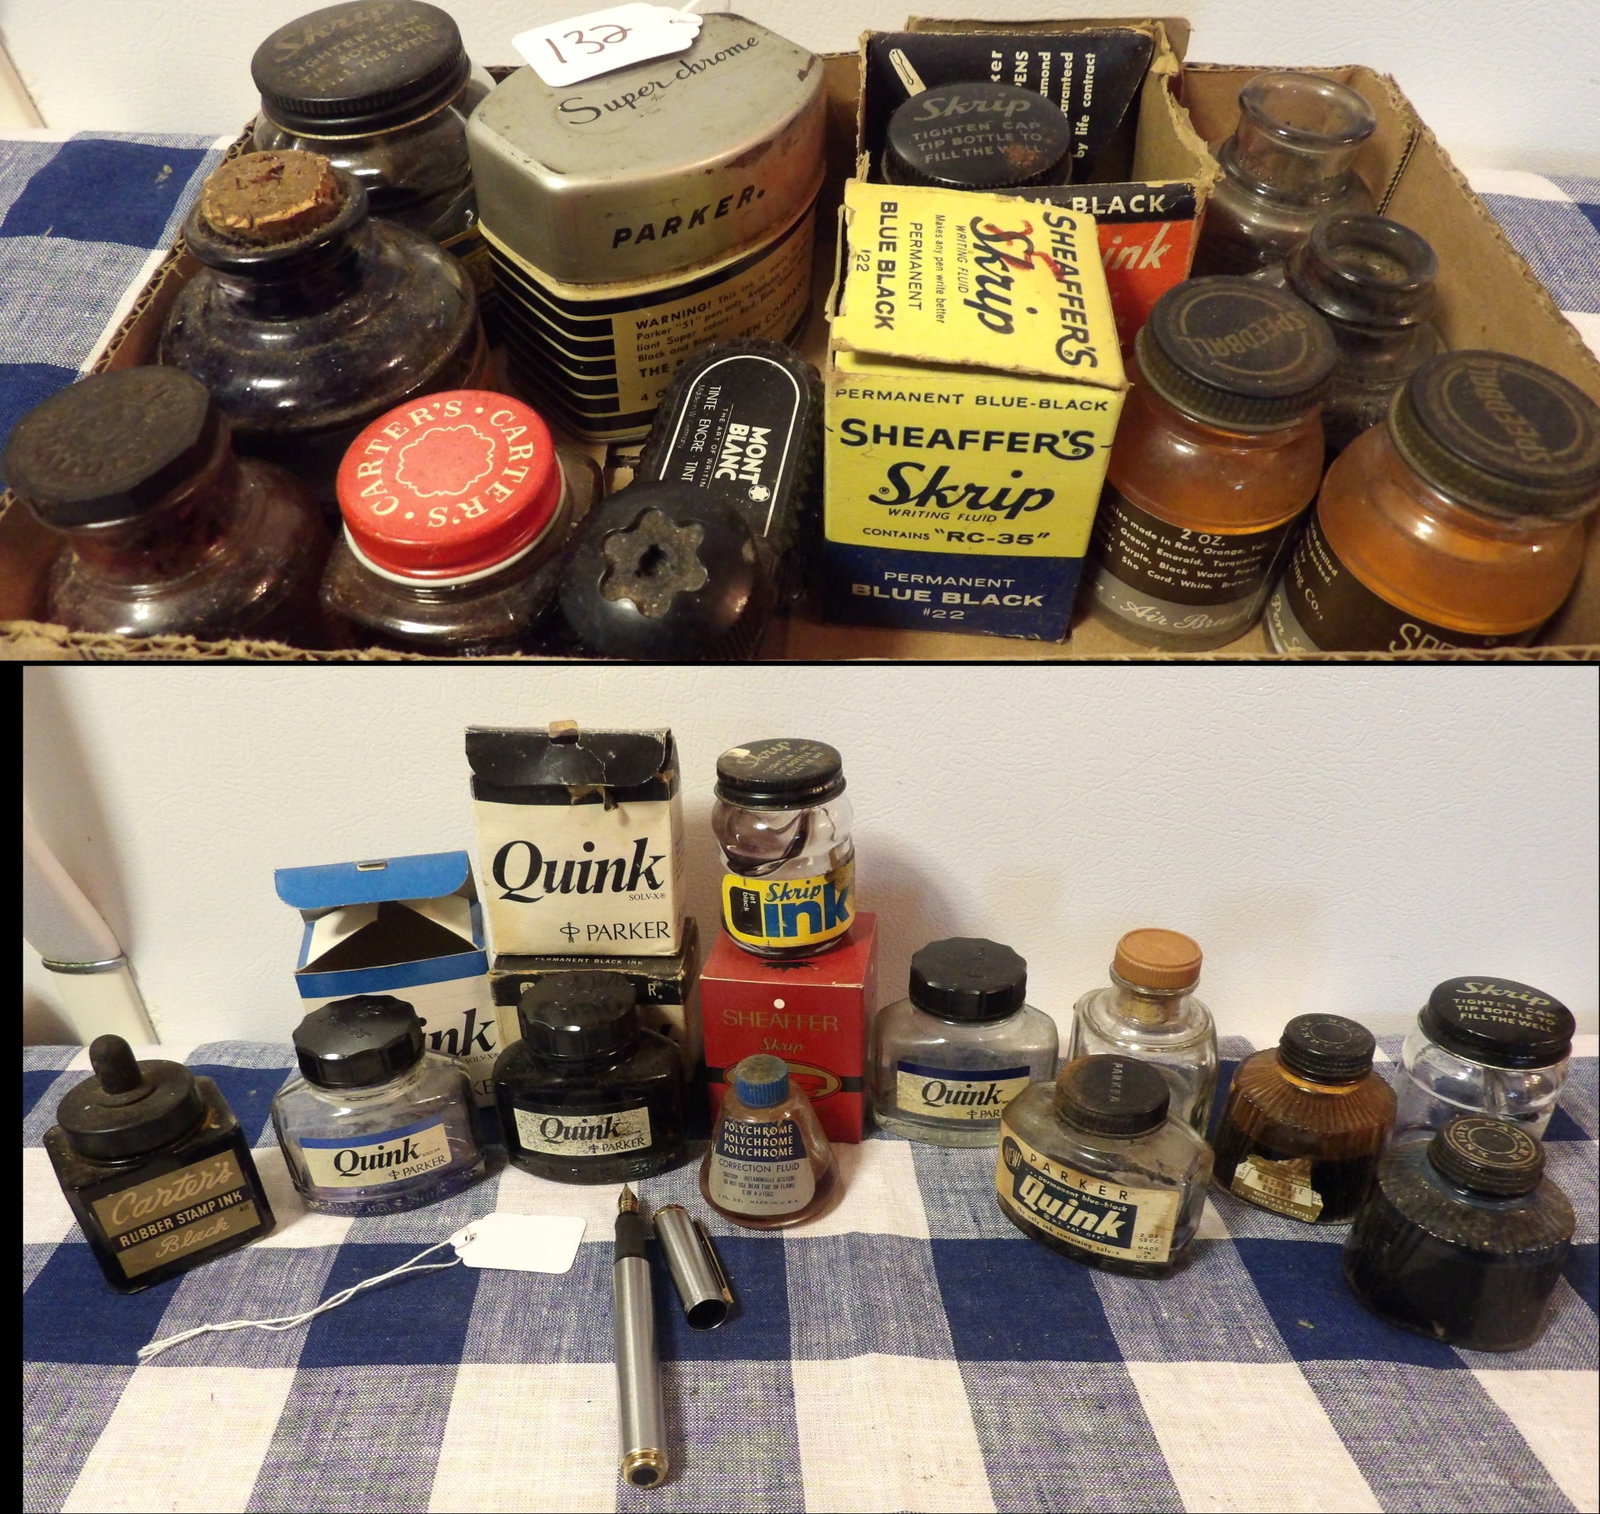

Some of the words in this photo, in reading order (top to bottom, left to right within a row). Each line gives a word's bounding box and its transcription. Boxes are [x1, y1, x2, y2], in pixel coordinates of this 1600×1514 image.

[544, 24, 632, 64] 132
[1081, 53, 1097, 108] contract
[913, 93, 1031, 121] Skrip
[912, 122, 990, 141] TIGHTEN
[1002, 121, 1041, 130] CAP
[1075, 114, 1090, 137] life
[918, 140, 945, 152] TIP
[952, 132, 1015, 146] BOTTLE
[1021, 133, 1042, 142] TO
[1074, 142, 1089, 159] by
[924, 152, 961, 164] FILL
[962, 146, 994, 157] THE
[1072, 195, 1166, 214] BLACK
[878, 201, 898, 253] BLUE
[935, 214, 946, 238] Makes
[935, 240, 944, 255] any
[955, 224, 969, 265] WRITING
[908, 222, 923, 311] PERMANENT
[935, 256, 945, 271] pen
[963, 216, 1039, 335] Skrip
[935, 273, 945, 295] write
[957, 266, 970, 294] FLUID
[1043, 211, 1098, 369] SHEAFFER'S
[874, 260, 897, 331] BLACK
[635, 301, 712, 330] WARNING!
[935, 297, 945, 324] better
[636, 327, 672, 341] Parker
[704, 311, 723, 323] pen
[667, 330, 697, 345] Super
[638, 350, 665, 363] Black
[669, 343, 690, 355] and
[639, 363, 669, 378] THE
[704, 385, 721, 411] TINTE
[836, 389, 964, 405] PERMANENT
[975, 395, 1108, 411] BLUE-BLACK
[718, 408, 729, 422] THE
[690, 418, 711, 452] ENCRE
[714, 426, 724, 442] ART
[840, 417, 1095, 461] SHEAFFER'S
[357, 399, 463, 516] CARTER'S
[710, 445, 718, 455] OF
[714, 423, 750, 481] BLANC
[739, 426, 772, 485] MONT
[427, 409, 535, 528] CARTER'S
[681, 461, 698, 482] TINT
[869, 461, 1055, 520] Skrip
[888, 508, 950, 520] WRITING
[957, 513, 997, 523] FLUID
[862, 527, 930, 540] CONTAINS
[934, 528, 1050, 546] "RC-35"
[1120, 527, 1150, 550] Green,
[1156, 547, 1204, 566] Emerald,
[1130, 520, 1158, 541] made
[1160, 536, 1171, 546] in
[1174, 540, 1199, 554] Red,
[1180, 528, 1193, 541] 2
[1198, 533, 1226, 547] OZ.
[1119, 540, 1152, 565] Purple,
[1158, 561, 1188, 576] Black
[1197, 570, 1228, 578] Water
[1121, 556, 1140, 571] Sho
[1147, 569, 1176, 586] Card,
[884, 572, 1016, 588] PERMANENT
[852, 583, 931, 602] BLUE
[941, 592, 1045, 607] BLACK
[923, 608, 965, 620] #22
[1119, 600, 1169, 626] Air
[492, 837, 667, 904] Quink
[765, 880, 820, 902] Skrip
[763, 882, 850, 938] ink
[587, 921, 671, 941] PARKER
[1456, 982, 1551, 1006] Skrip
[1453, 998, 1517, 1009] TIGHTEN
[1525, 1007, 1557, 1018] CAP
[1483, 1008, 1533, 1020] BOTTLE
[1538, 1017, 1556, 1025] TO
[722, 1009, 839, 1032] SHEAFFER
[1460, 1013, 1488, 1021] FILL
[1491, 1015, 1516, 1024] THE
[1518, 1020, 1552, 1032] WELL
[760, 1037, 804, 1053] Skrip
[1109, 1062, 1125, 1102] PARKER
[922, 1081, 1005, 1108] Quink
[539, 1116, 620, 1144] Quink
[724, 1121, 793, 1136] POLYCHROME
[724, 1133, 794, 1147] POLYCHROME
[602, 1137, 645, 1152] PARKER
[723, 1143, 794, 1157] POLYCHROME
[333, 1137, 421, 1177] Quink
[403, 1155, 447, 1177] PARKER
[718, 1159, 771, 1173] CORRECTION
[776, 1163, 800, 1173] FLUID
[1005, 1145, 1021, 1170] NEW!
[1030, 1153, 1130, 1201] PARKER
[112, 1161, 233, 1225] Carter's
[1081, 1194, 1128, 1213] blue-black
[1019, 1174, 1126, 1239] Quink
[120, 1218, 175, 1247] RUBBER
[176, 1201, 215, 1226] STAMP
[218, 1192, 243, 1208] INK
[156, 1217, 230, 1258] Black
[1027, 1215, 1040, 1225] only
[1042, 1222, 1054, 1232] ink
[1056, 1231, 1093, 1250] containing
